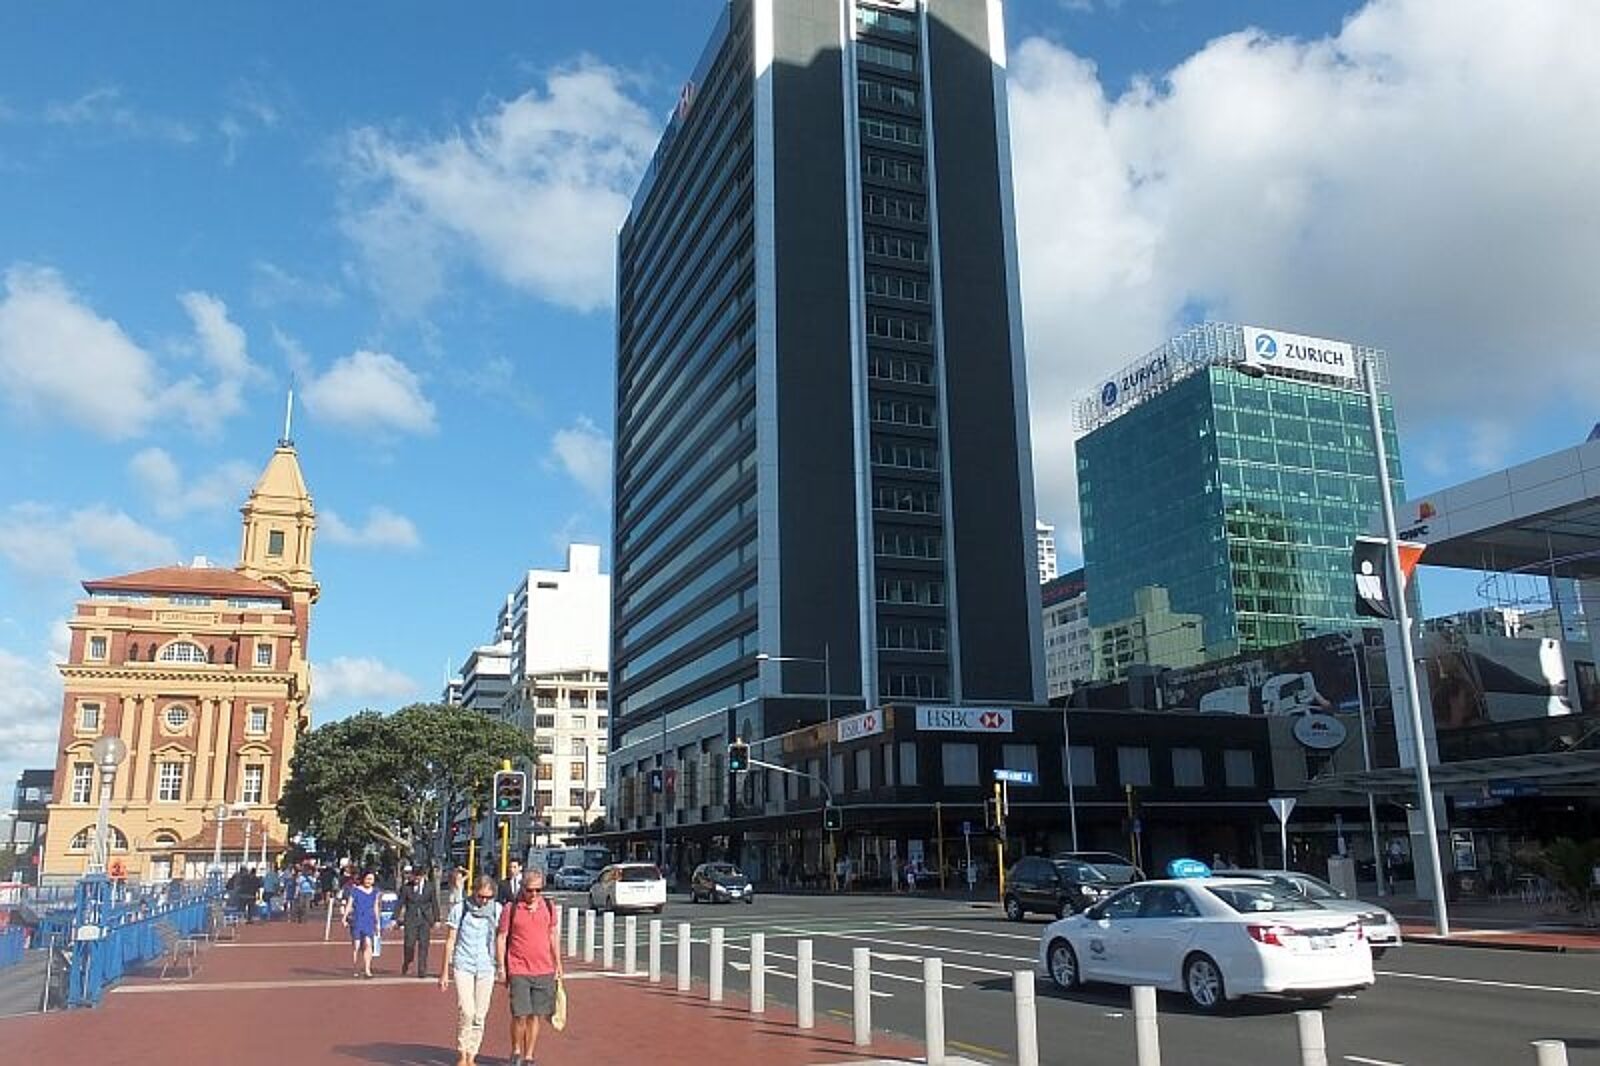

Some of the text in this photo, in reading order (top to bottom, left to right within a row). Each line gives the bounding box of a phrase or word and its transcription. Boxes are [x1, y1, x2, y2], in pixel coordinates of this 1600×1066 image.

[1285, 344, 1344, 366] ZURICH
[1122, 353, 1167, 390] ZURICH
[927, 709, 974, 729] HSBC
